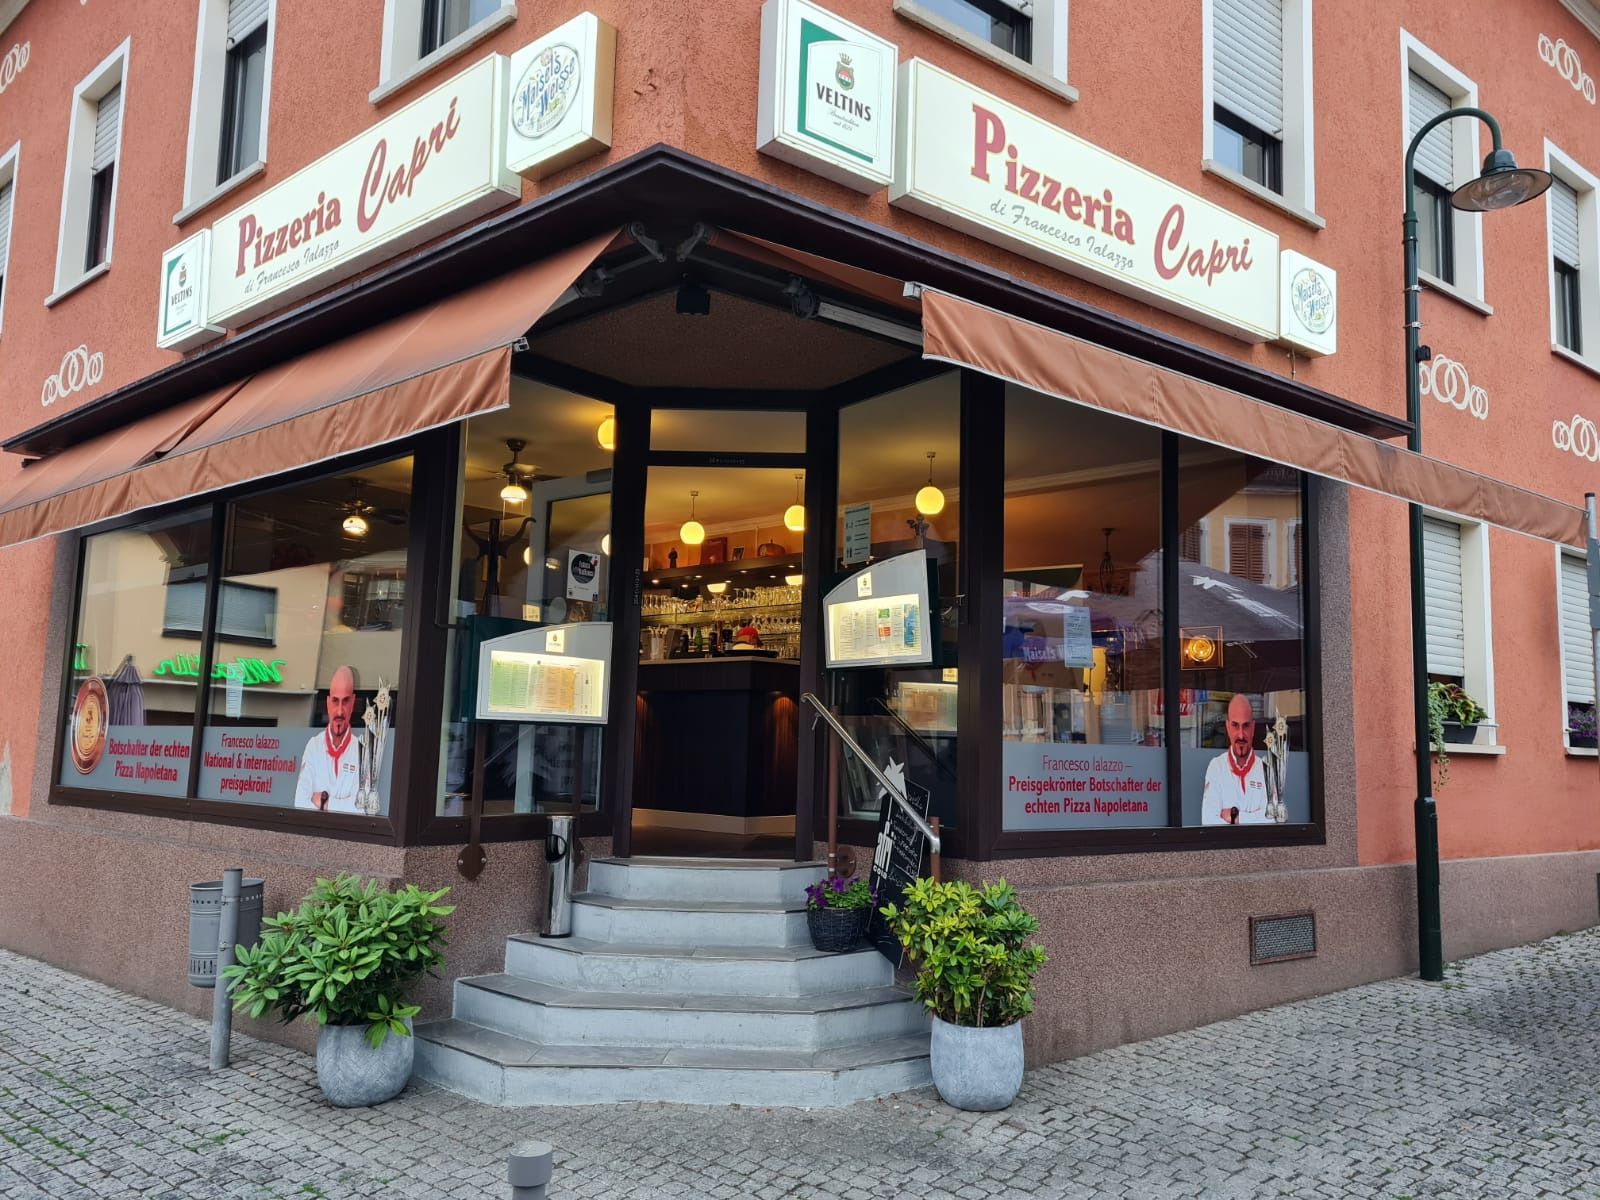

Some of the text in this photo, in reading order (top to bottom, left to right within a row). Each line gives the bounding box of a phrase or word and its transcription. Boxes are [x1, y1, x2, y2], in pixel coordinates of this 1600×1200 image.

[816, 82, 871, 122] VELTINS
[235, 96, 461, 278] Pizzeria Capri
[971, 103, 1253, 287] Pizzeria Capri
[990, 200, 1007, 216] di
[1011, 204, 1081, 247] Francesco
[244, 279, 255, 294] di
[256, 260, 300, 292] Francesco
[171, 286, 193, 306] VELTINS
[109, 738, 191, 759] Botschafter der echten
[220, 733, 254, 749] Francesco
[115, 760, 178, 784] Pizza Napoletana
[204, 751, 297, 774] National & international
[1042, 754, 1090, 771] Francesco
[220, 774, 273, 796] preisgekrönt!
[1008, 775, 1162, 796] Preisgekrönter Botschafter der
[1025, 797, 1149, 816] echten Pizza Napoletana
